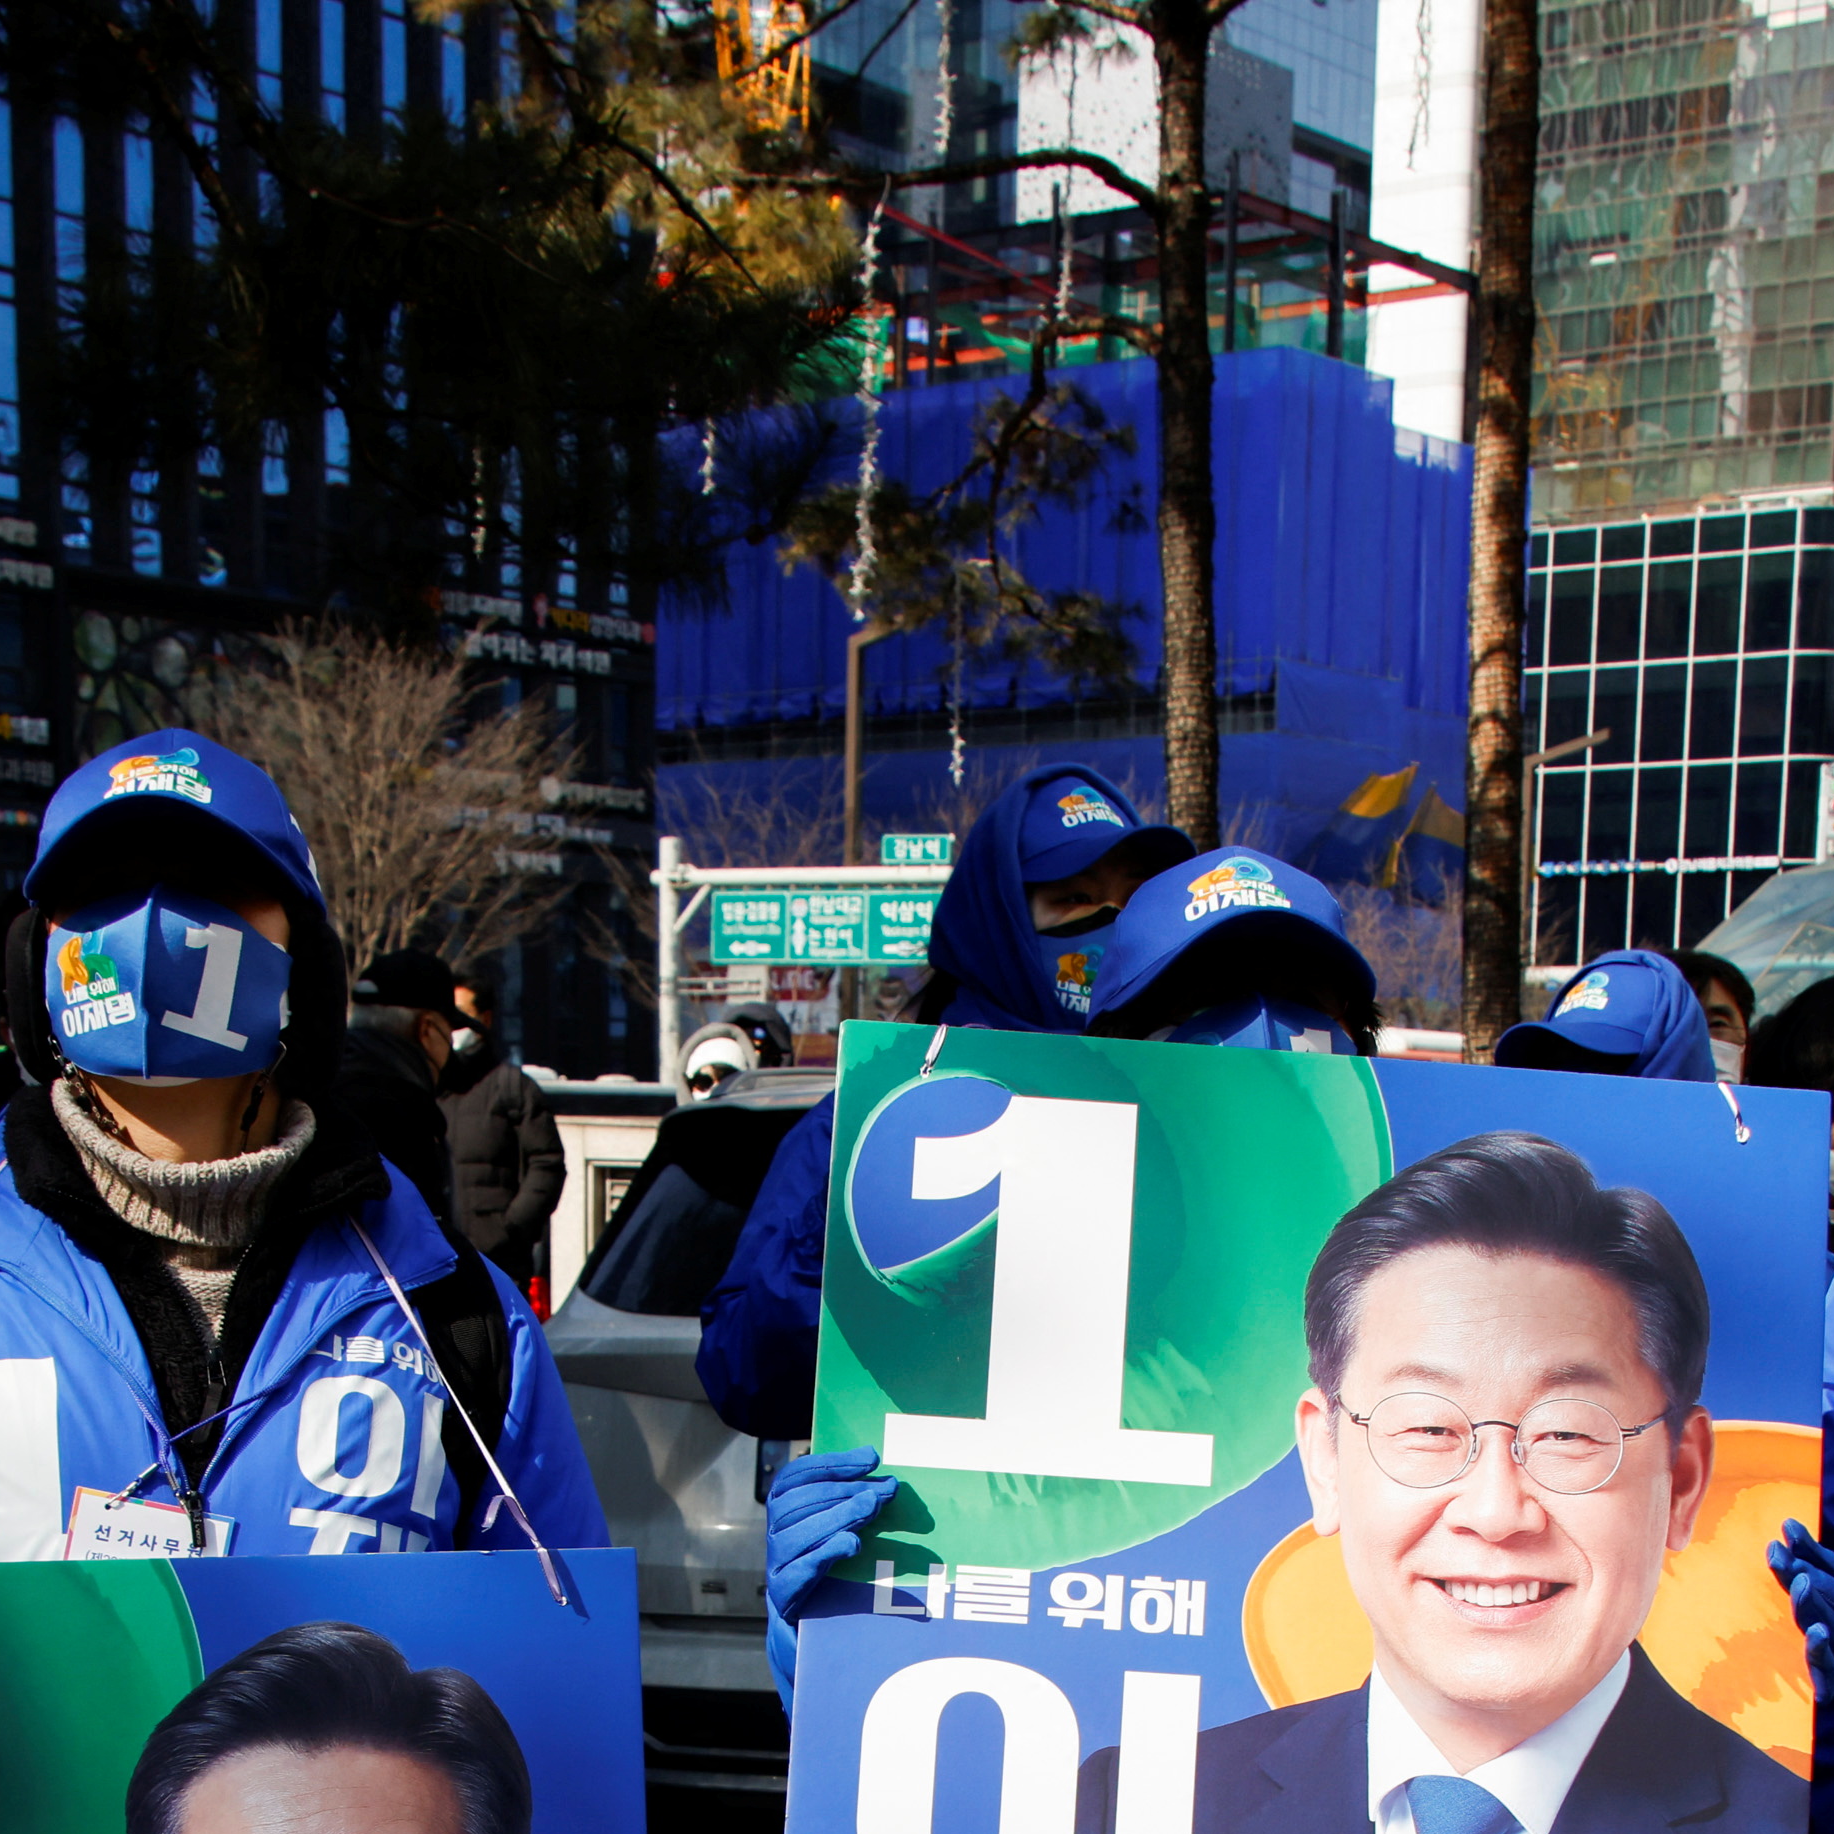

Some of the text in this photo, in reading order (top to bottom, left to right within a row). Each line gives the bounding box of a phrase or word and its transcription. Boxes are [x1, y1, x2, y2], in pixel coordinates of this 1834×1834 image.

[104, 774, 213, 804] 이재명
[61, 992, 137, 1038] 이재명
[160, 922, 250, 1052] 1
[879, 1094, 1216, 1488] 1
[873, 1560, 1208, 1637] 나를 위해
